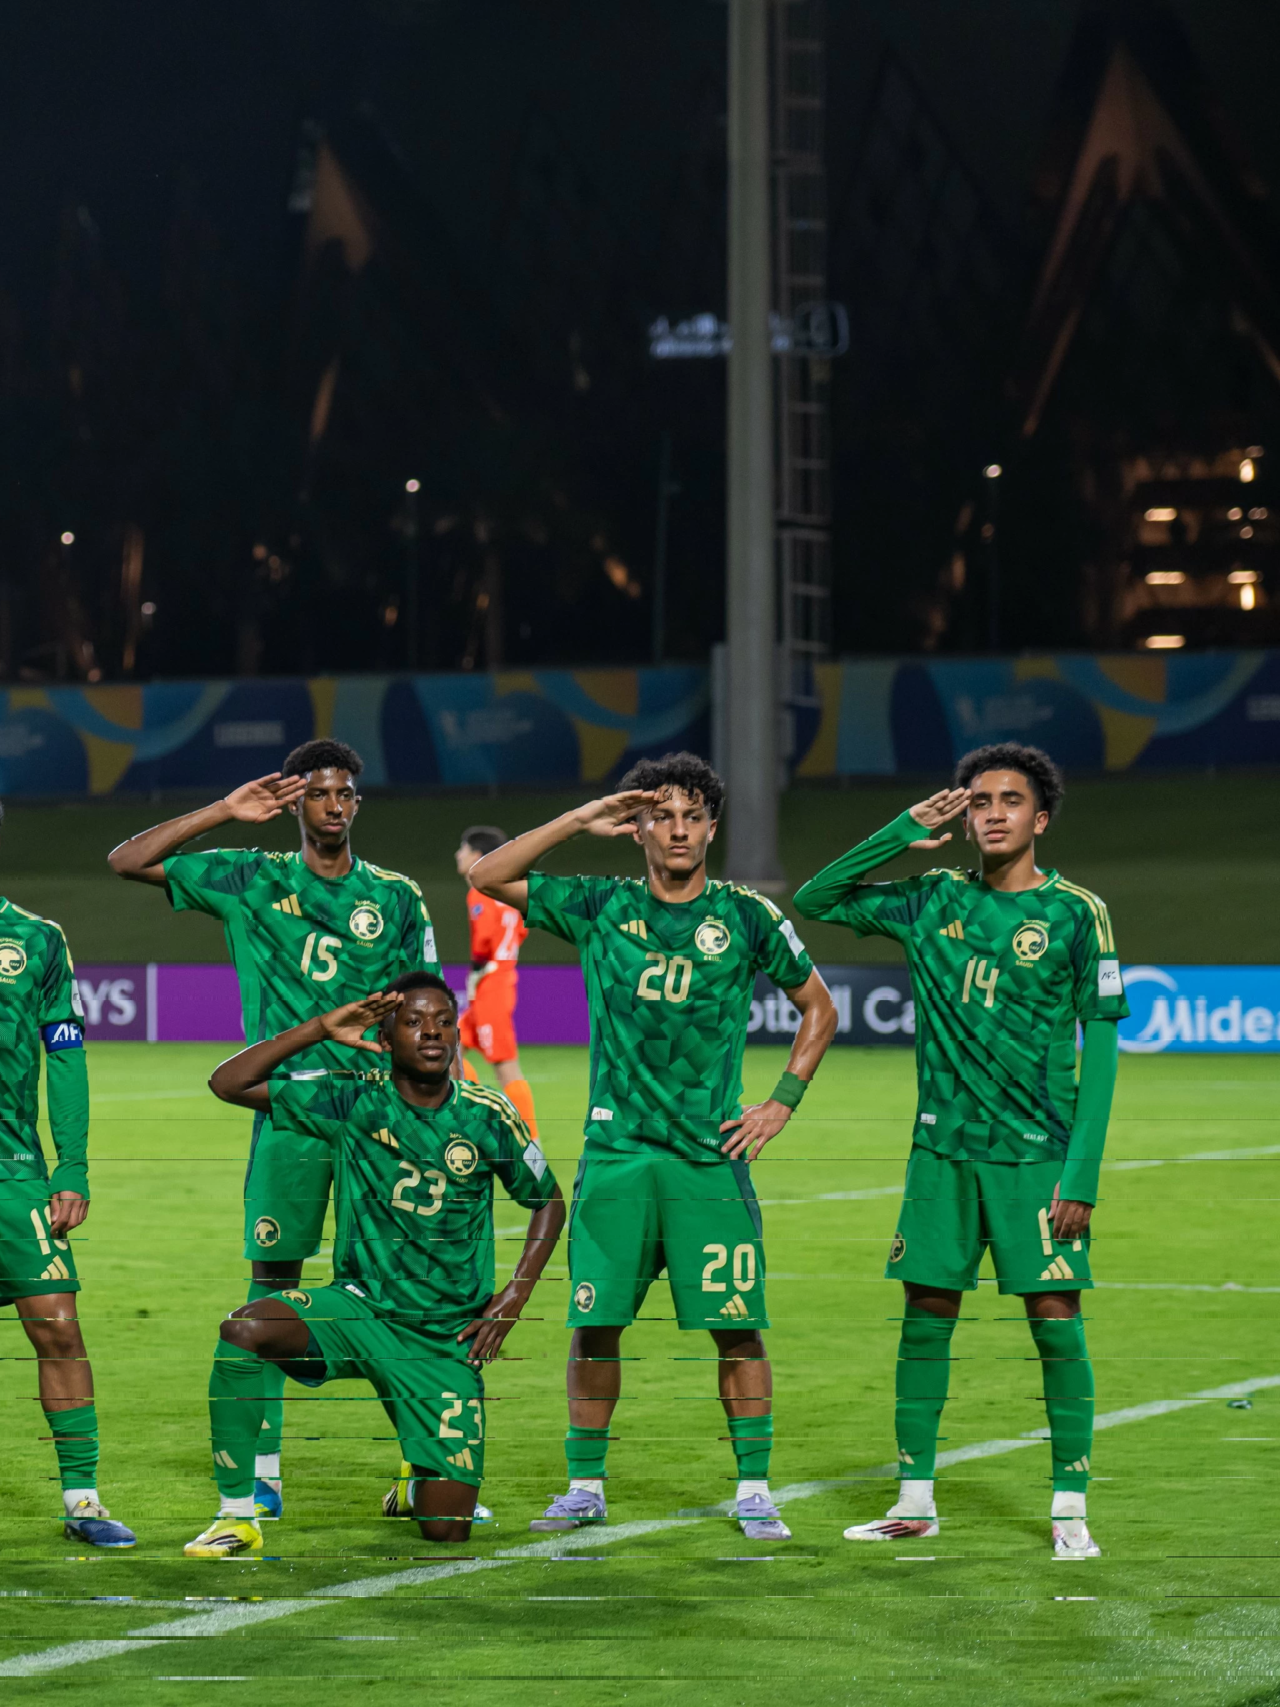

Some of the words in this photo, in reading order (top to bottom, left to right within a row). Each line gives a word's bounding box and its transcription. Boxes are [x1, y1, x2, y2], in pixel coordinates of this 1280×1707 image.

[301, 927, 342, 981] 15
[637, 952, 692, 1003] 20
[80, 979, 136, 1025] YS
[962, 956, 999, 1008] 14
[1136, 995, 1280, 1043] Mide
[391, 1160, 447, 1216] 23
[1038, 1207, 1082, 1256] 1
[701, 1243, 756, 1292] 20
[439, 1391, 482, 1445] 23
